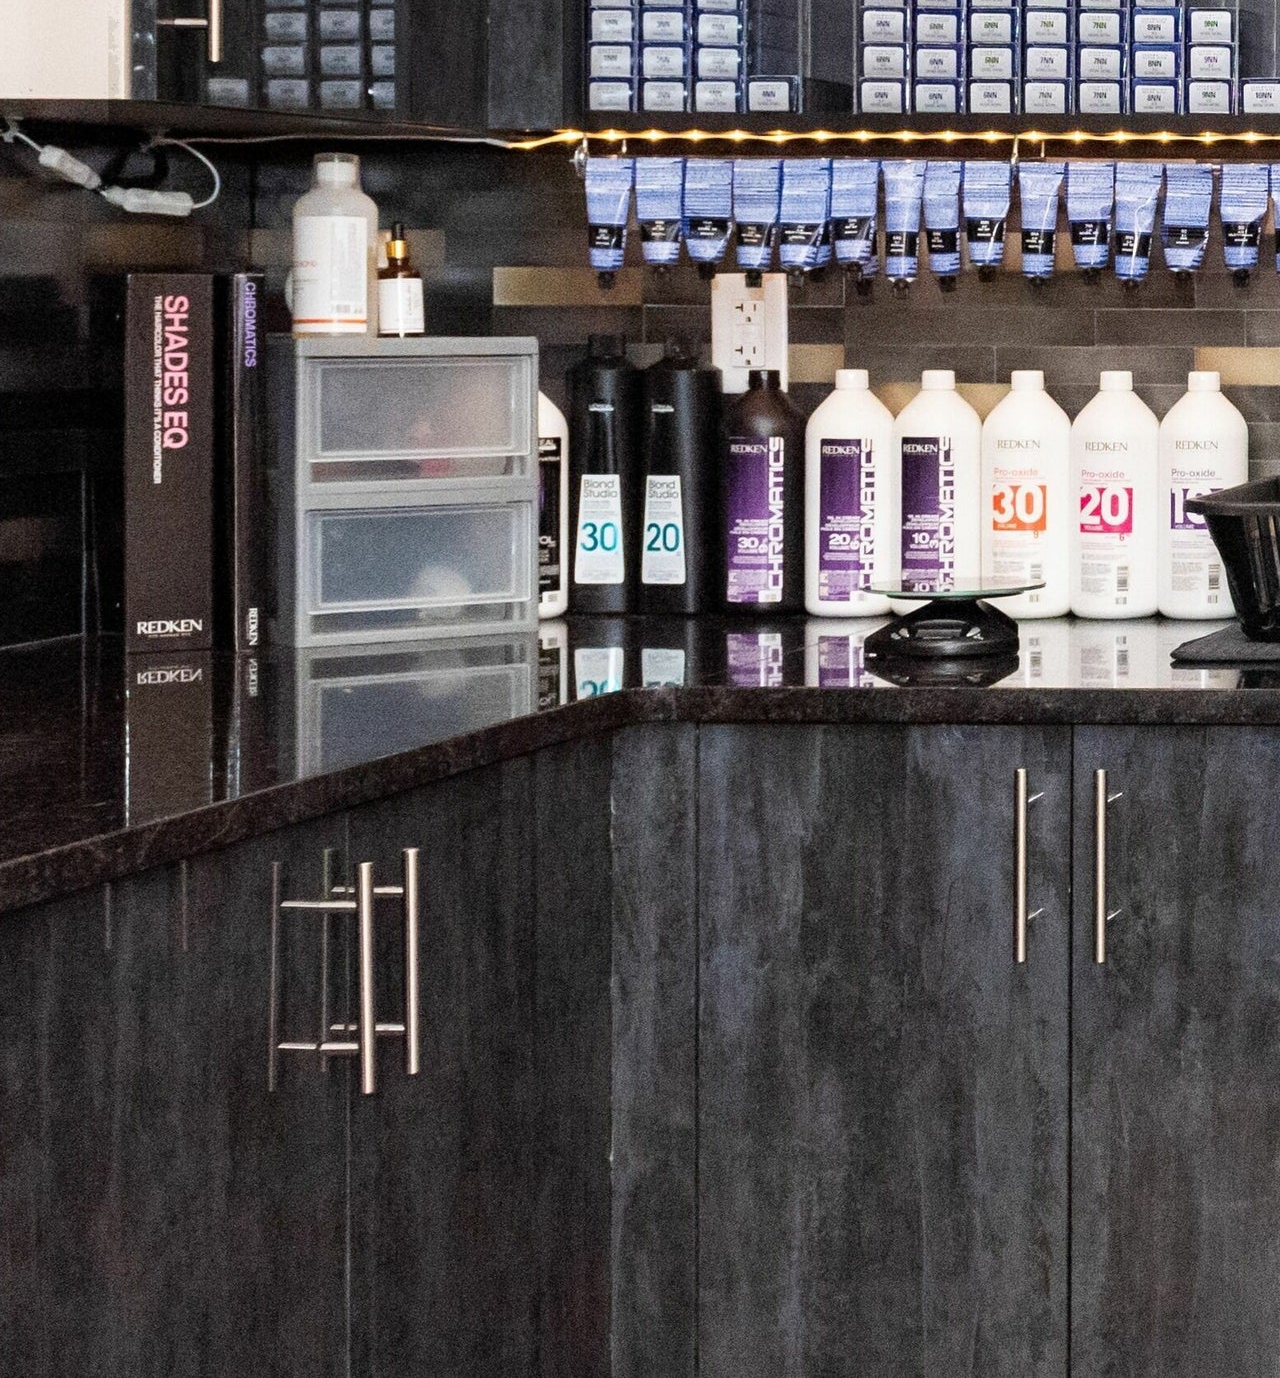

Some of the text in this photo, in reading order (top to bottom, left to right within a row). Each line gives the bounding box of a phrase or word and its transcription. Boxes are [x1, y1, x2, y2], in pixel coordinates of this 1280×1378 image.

[245, 282, 257, 367] CHROMATICS
[162, 295, 189, 449] SHADES EQ
[730, 444, 768, 454] REDKEN
[902, 444, 938, 453] REDKEN
[997, 439, 1041, 449] REDKEN
[1085, 442, 1128, 452] REDKEN
[1175, 440, 1218, 450] REDKEN
[822, 445, 860, 455] REDKEN
[993, 467, 1039, 477] Pro-oxide
[1081, 469, 1125, 479] Pro-oxide
[1171, 468, 1216, 478] Pro-oxide
[584, 479, 615, 489] Blond
[583, 489, 618, 499] Studio
[649, 490, 679, 499] Studio
[992, 483, 1043, 523] 30
[1080, 485, 1129, 526] 20
[768, 437, 784, 589] CHROMATICS
[580, 522, 618, 552] 30
[646, 523, 680, 552] 20
[828, 533, 850, 545] 20
[911, 532, 930, 544] 10
[737, 537, 759, 549] 30
[137, 619, 202, 634] REDKEN
